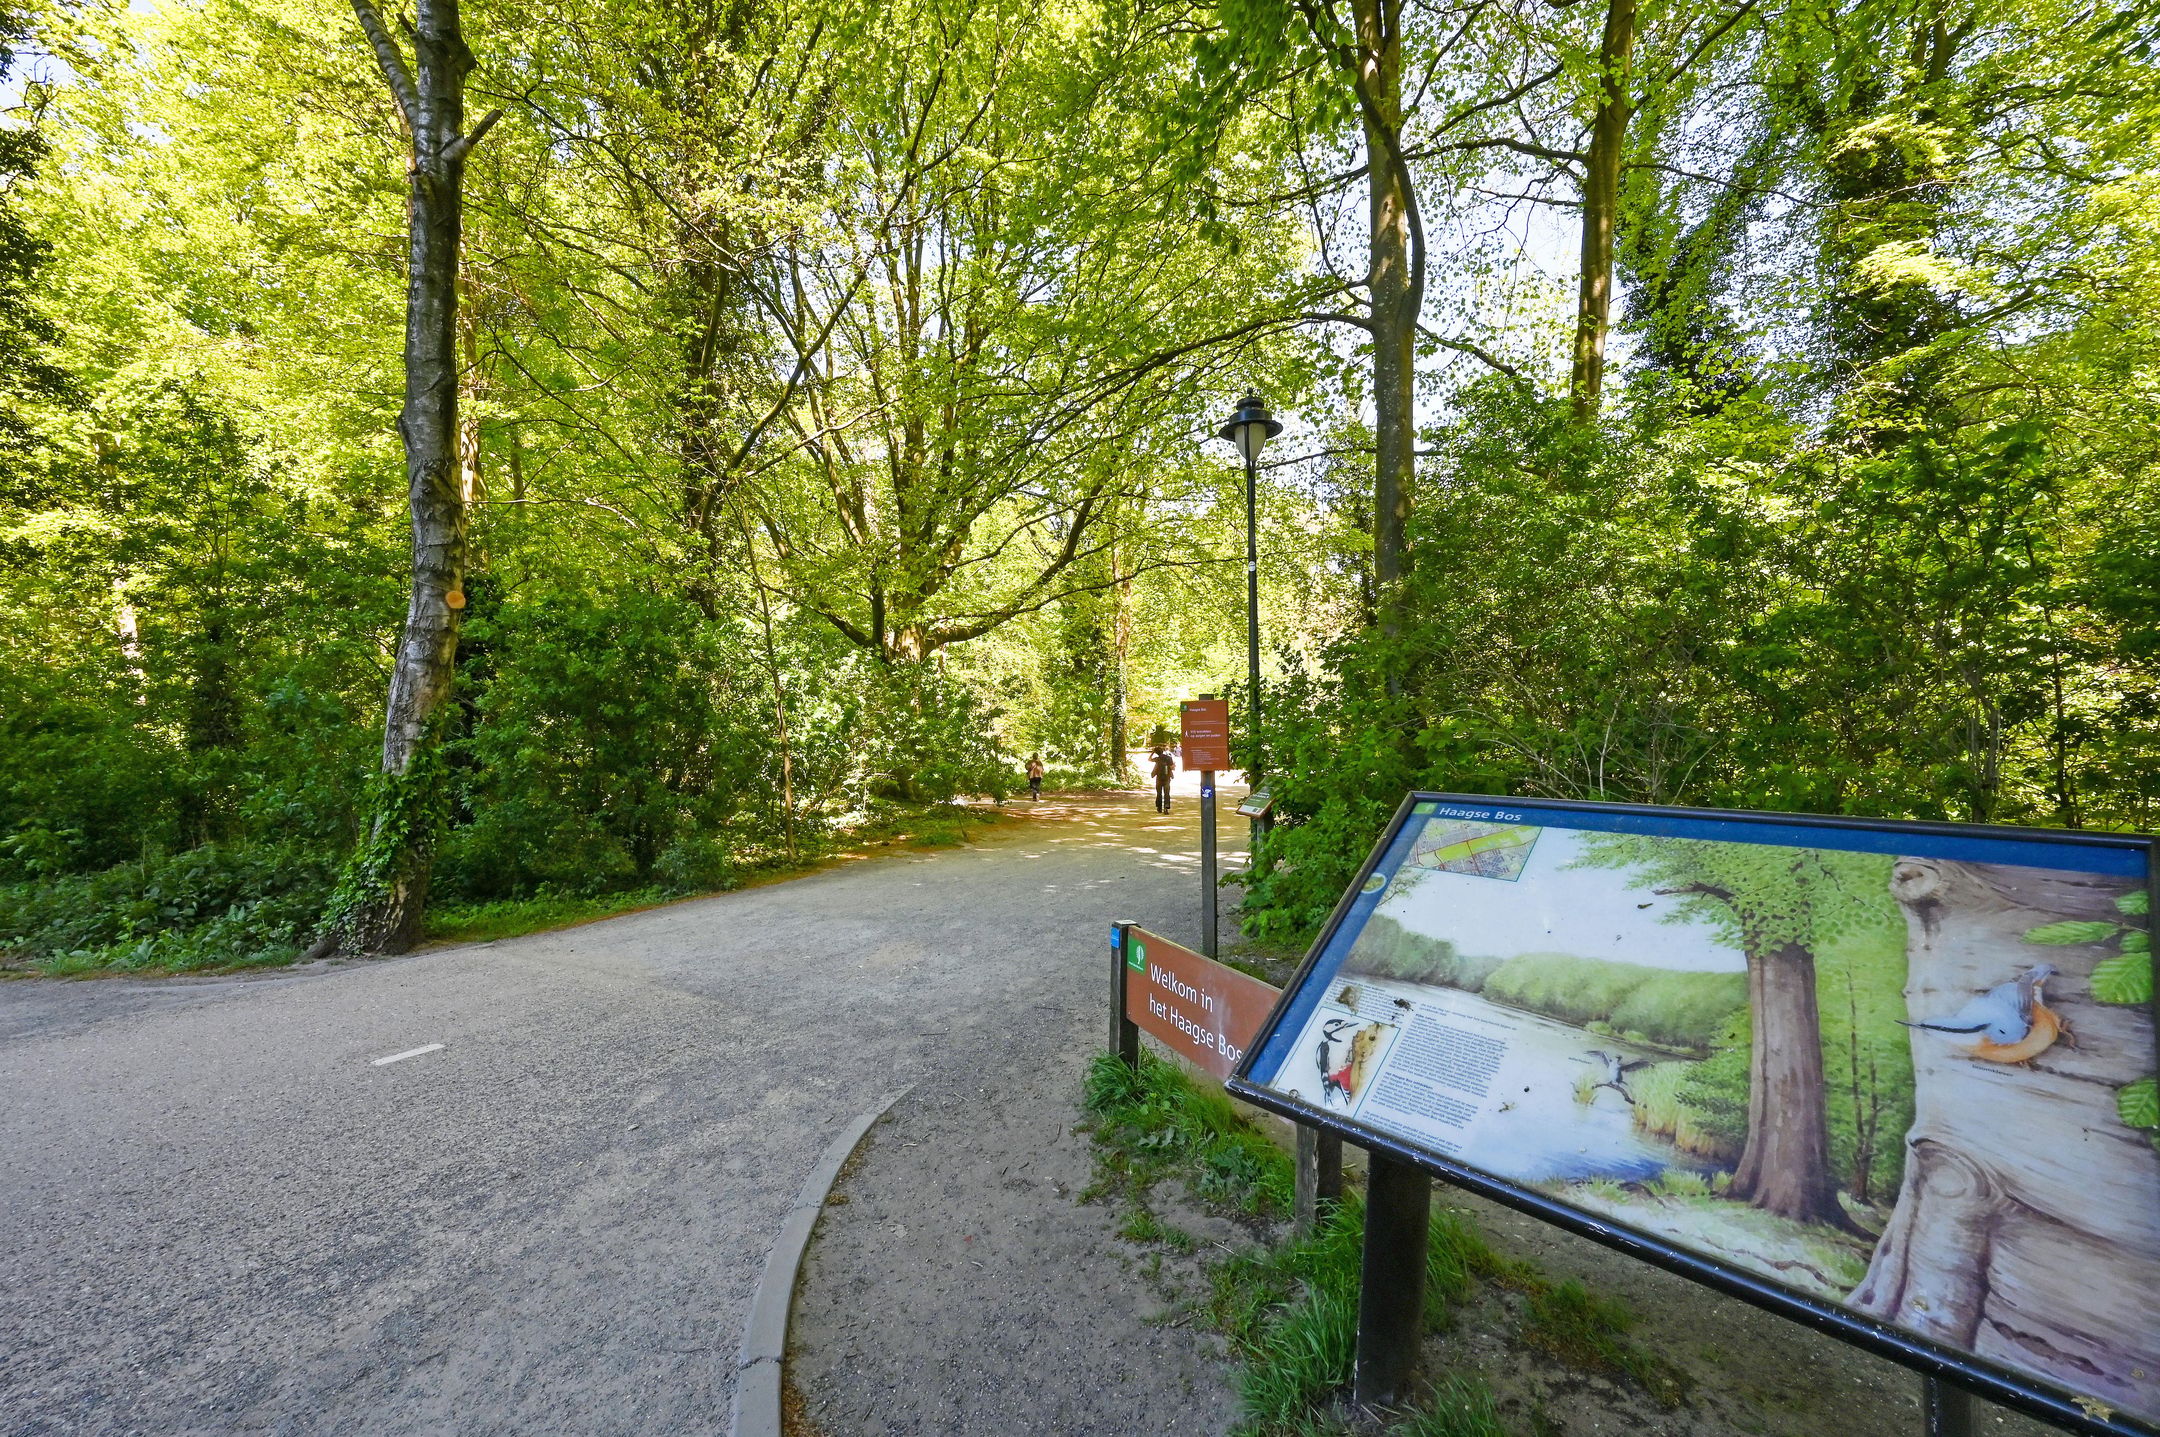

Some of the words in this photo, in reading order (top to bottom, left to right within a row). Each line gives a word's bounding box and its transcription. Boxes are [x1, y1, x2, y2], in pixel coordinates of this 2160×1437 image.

[1439, 807, 1490, 819] Haagse
[1495, 811, 1522, 821] Bos
[1150, 962, 1197, 1004] Welkom
[1200, 988, 1213, 1013] in
[1149, 992, 1167, 1021] het
[1170, 1006, 1214, 1049] Haagse
[1218, 1033, 1243, 1064] Bos
